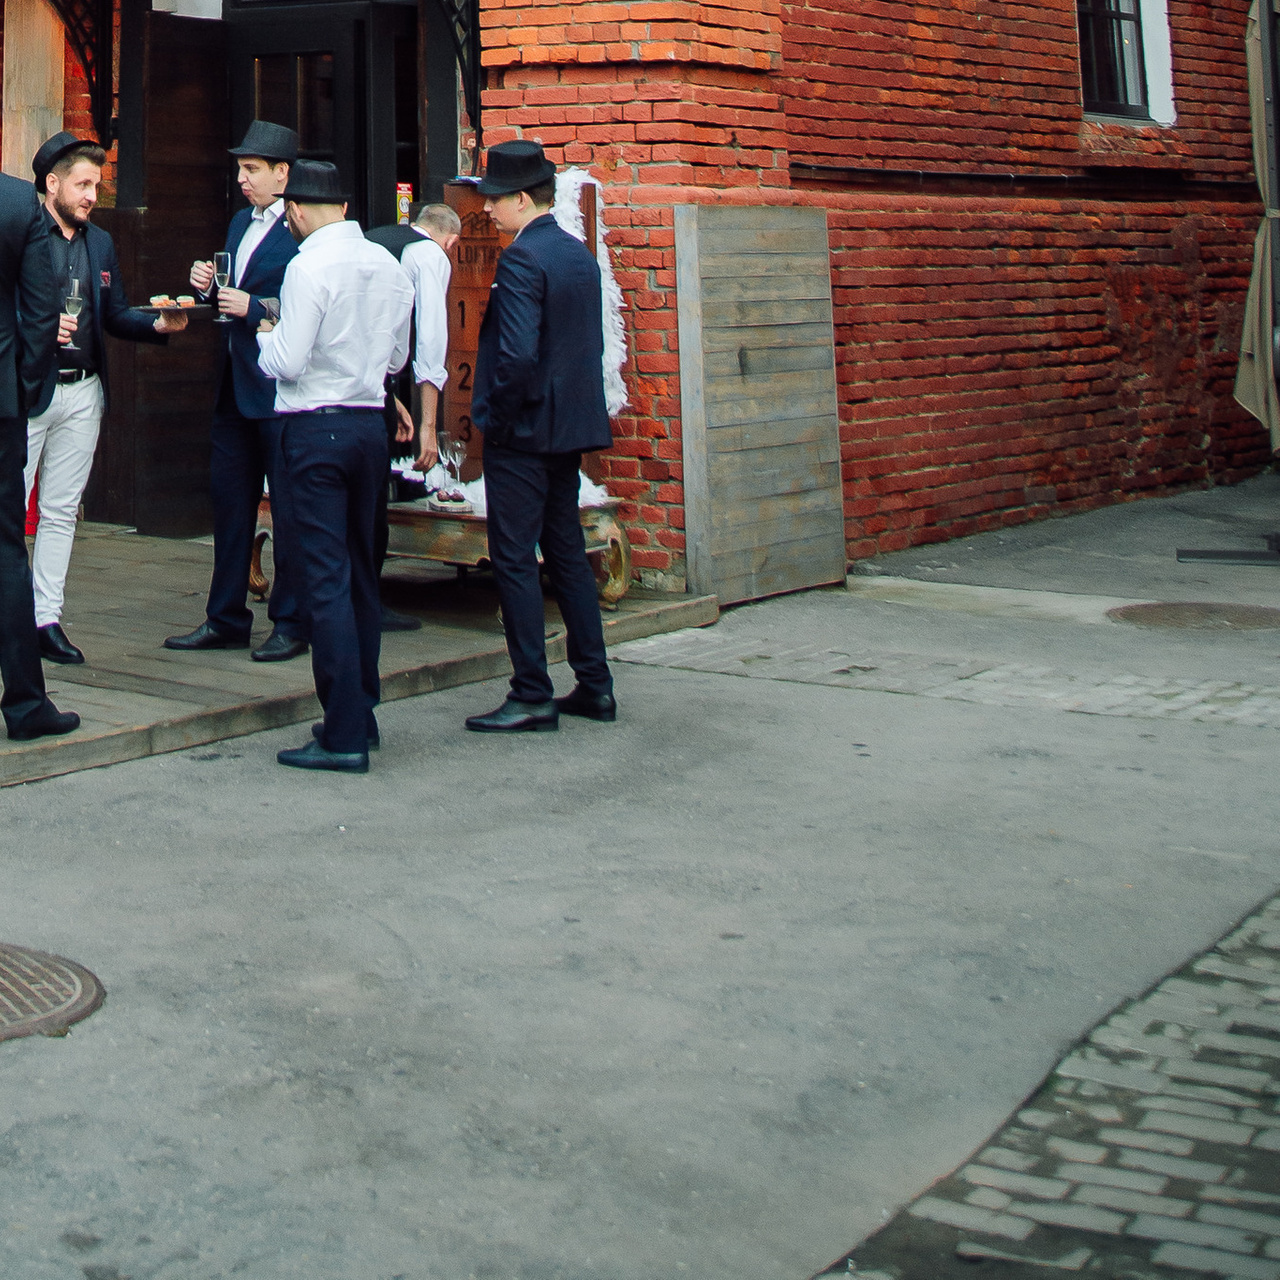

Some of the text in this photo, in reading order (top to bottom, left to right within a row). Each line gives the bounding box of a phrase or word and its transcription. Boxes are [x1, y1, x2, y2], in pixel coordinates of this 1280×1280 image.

[458, 299, 465, 329] 1
[458, 362, 472, 391] 2
[458, 415, 472, 443] 3
